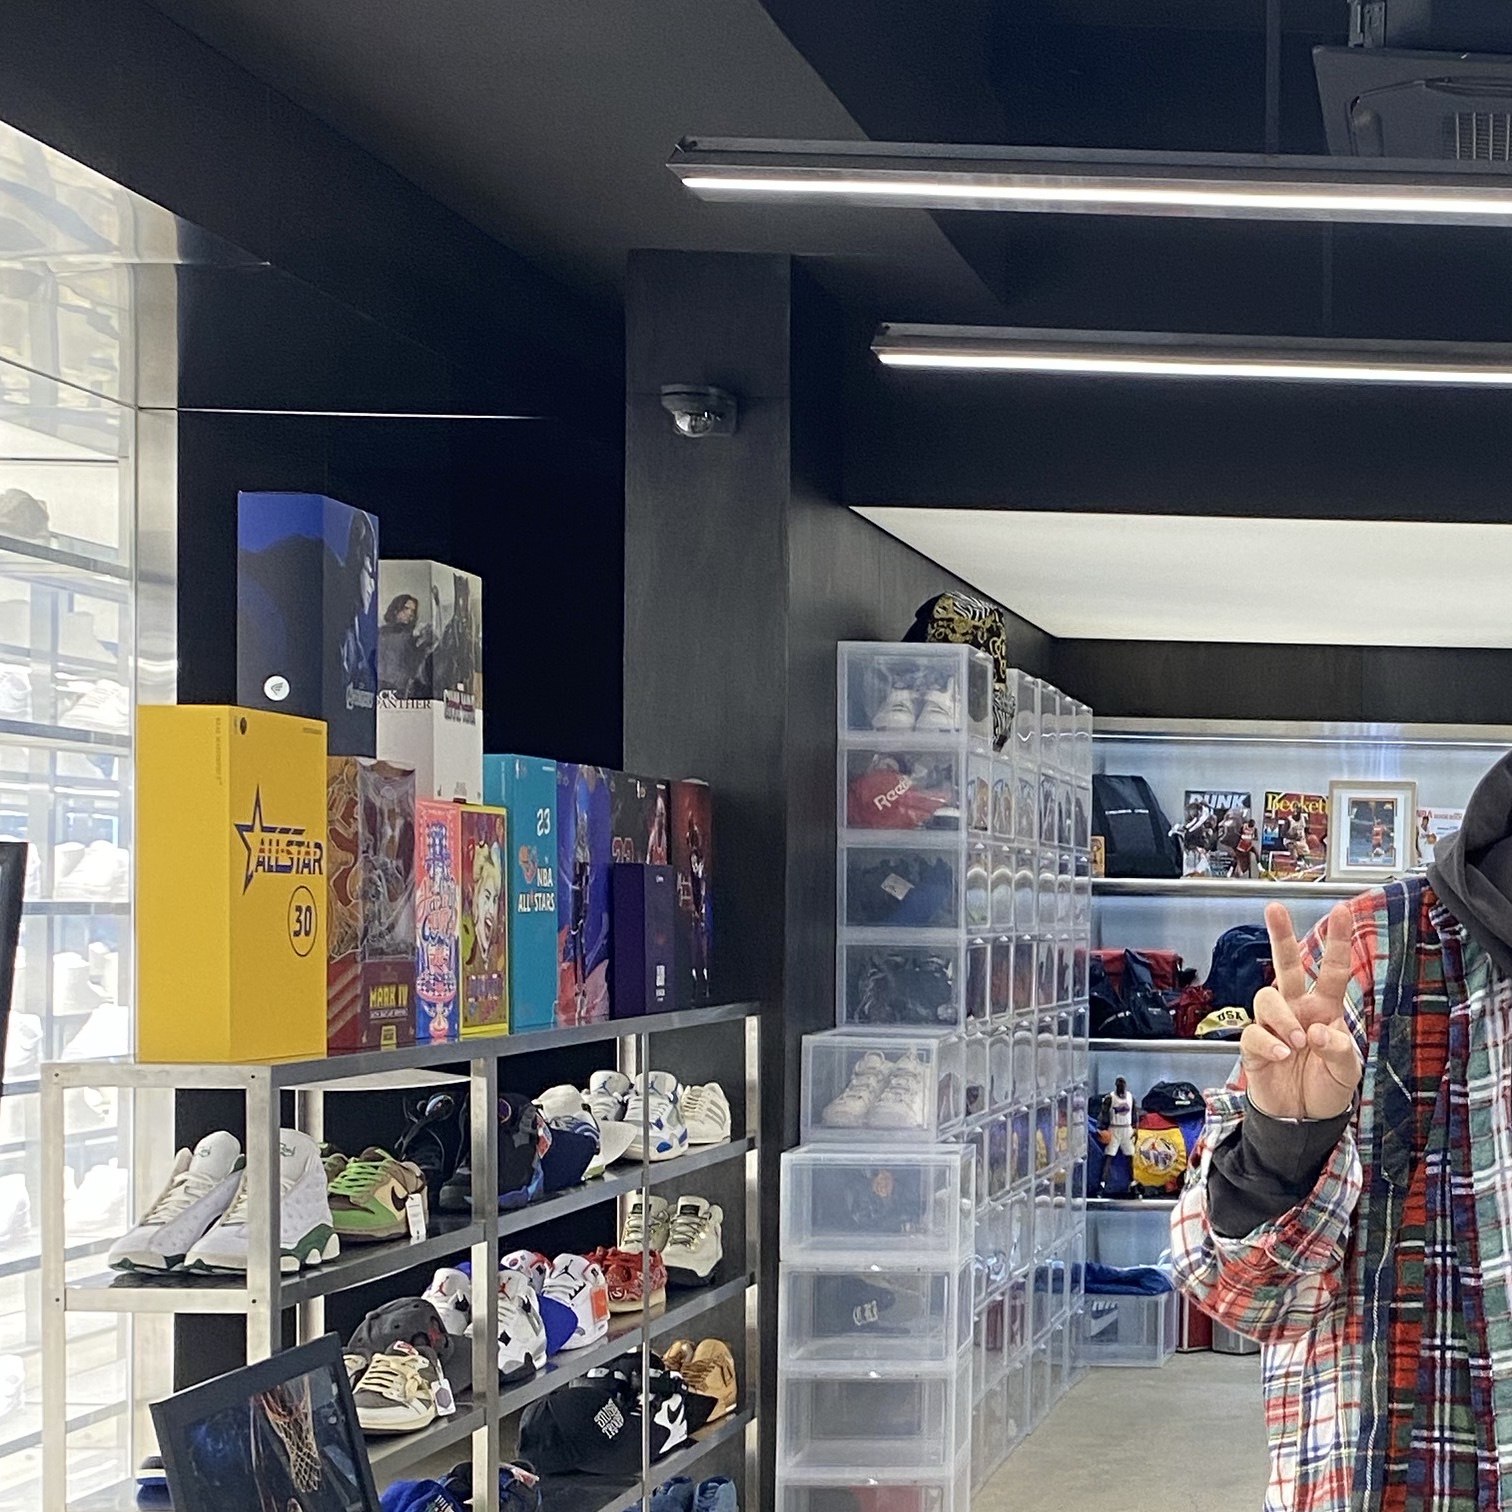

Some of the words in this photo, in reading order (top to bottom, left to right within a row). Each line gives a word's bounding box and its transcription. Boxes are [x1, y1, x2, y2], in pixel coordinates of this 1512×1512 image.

[377, 699, 431, 710] ANTHER
[537, 808, 551, 837] 23
[537, 868, 553, 888] NBA
[534, 893, 556, 912] STARS
[293, 905, 312, 937] 30
[369, 984, 397, 1008] MARK
[1216, 1010, 1244, 1022] USA
